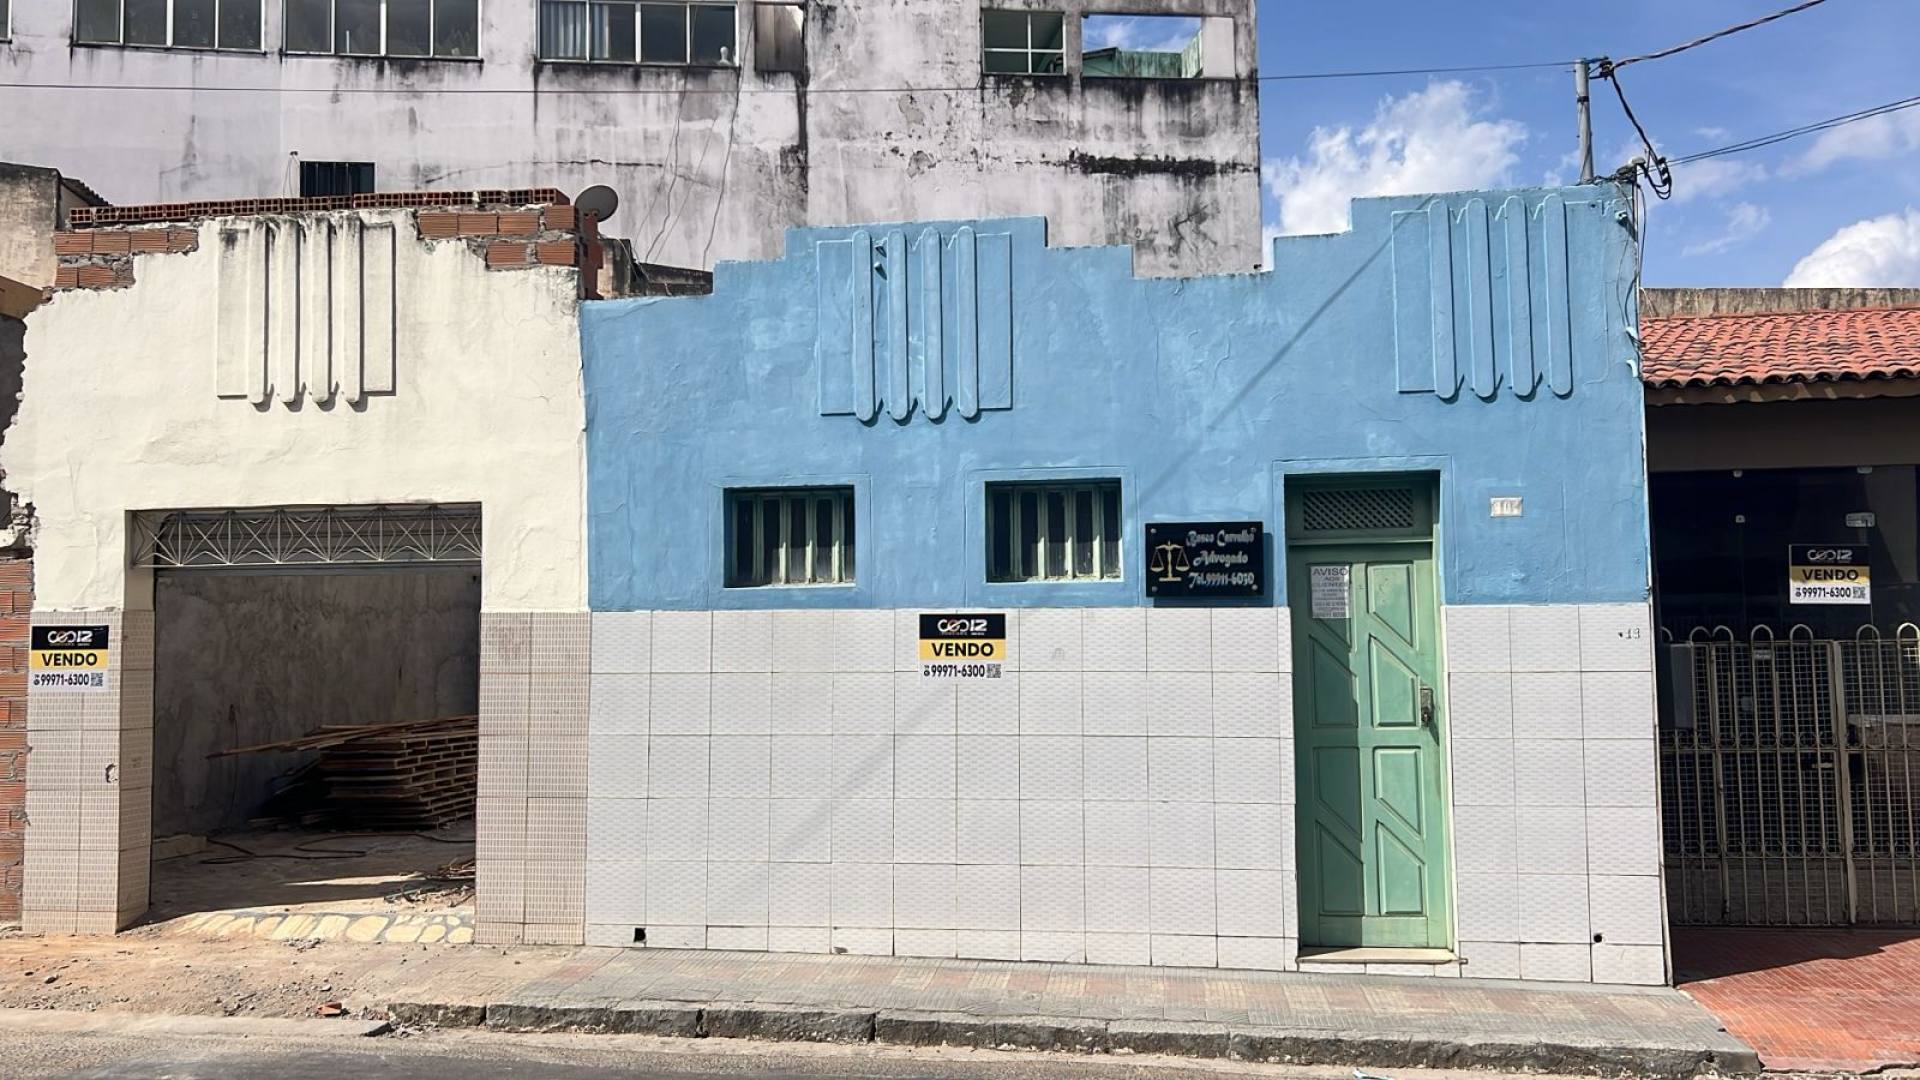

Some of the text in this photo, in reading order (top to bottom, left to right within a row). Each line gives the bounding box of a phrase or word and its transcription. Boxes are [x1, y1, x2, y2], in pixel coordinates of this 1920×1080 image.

[1192, 550, 1249, 568] Advogado
[1312, 567, 1349, 576] AVISO
[1802, 568, 1859, 581] VENDO
[1802, 587, 1851, 598] 99971-6300
[931, 642, 995, 657] VENDO
[41, 652, 98, 667] VENDO
[930, 664, 986, 678] 99971-6300
[40, 673, 90, 686] 99971-6300
